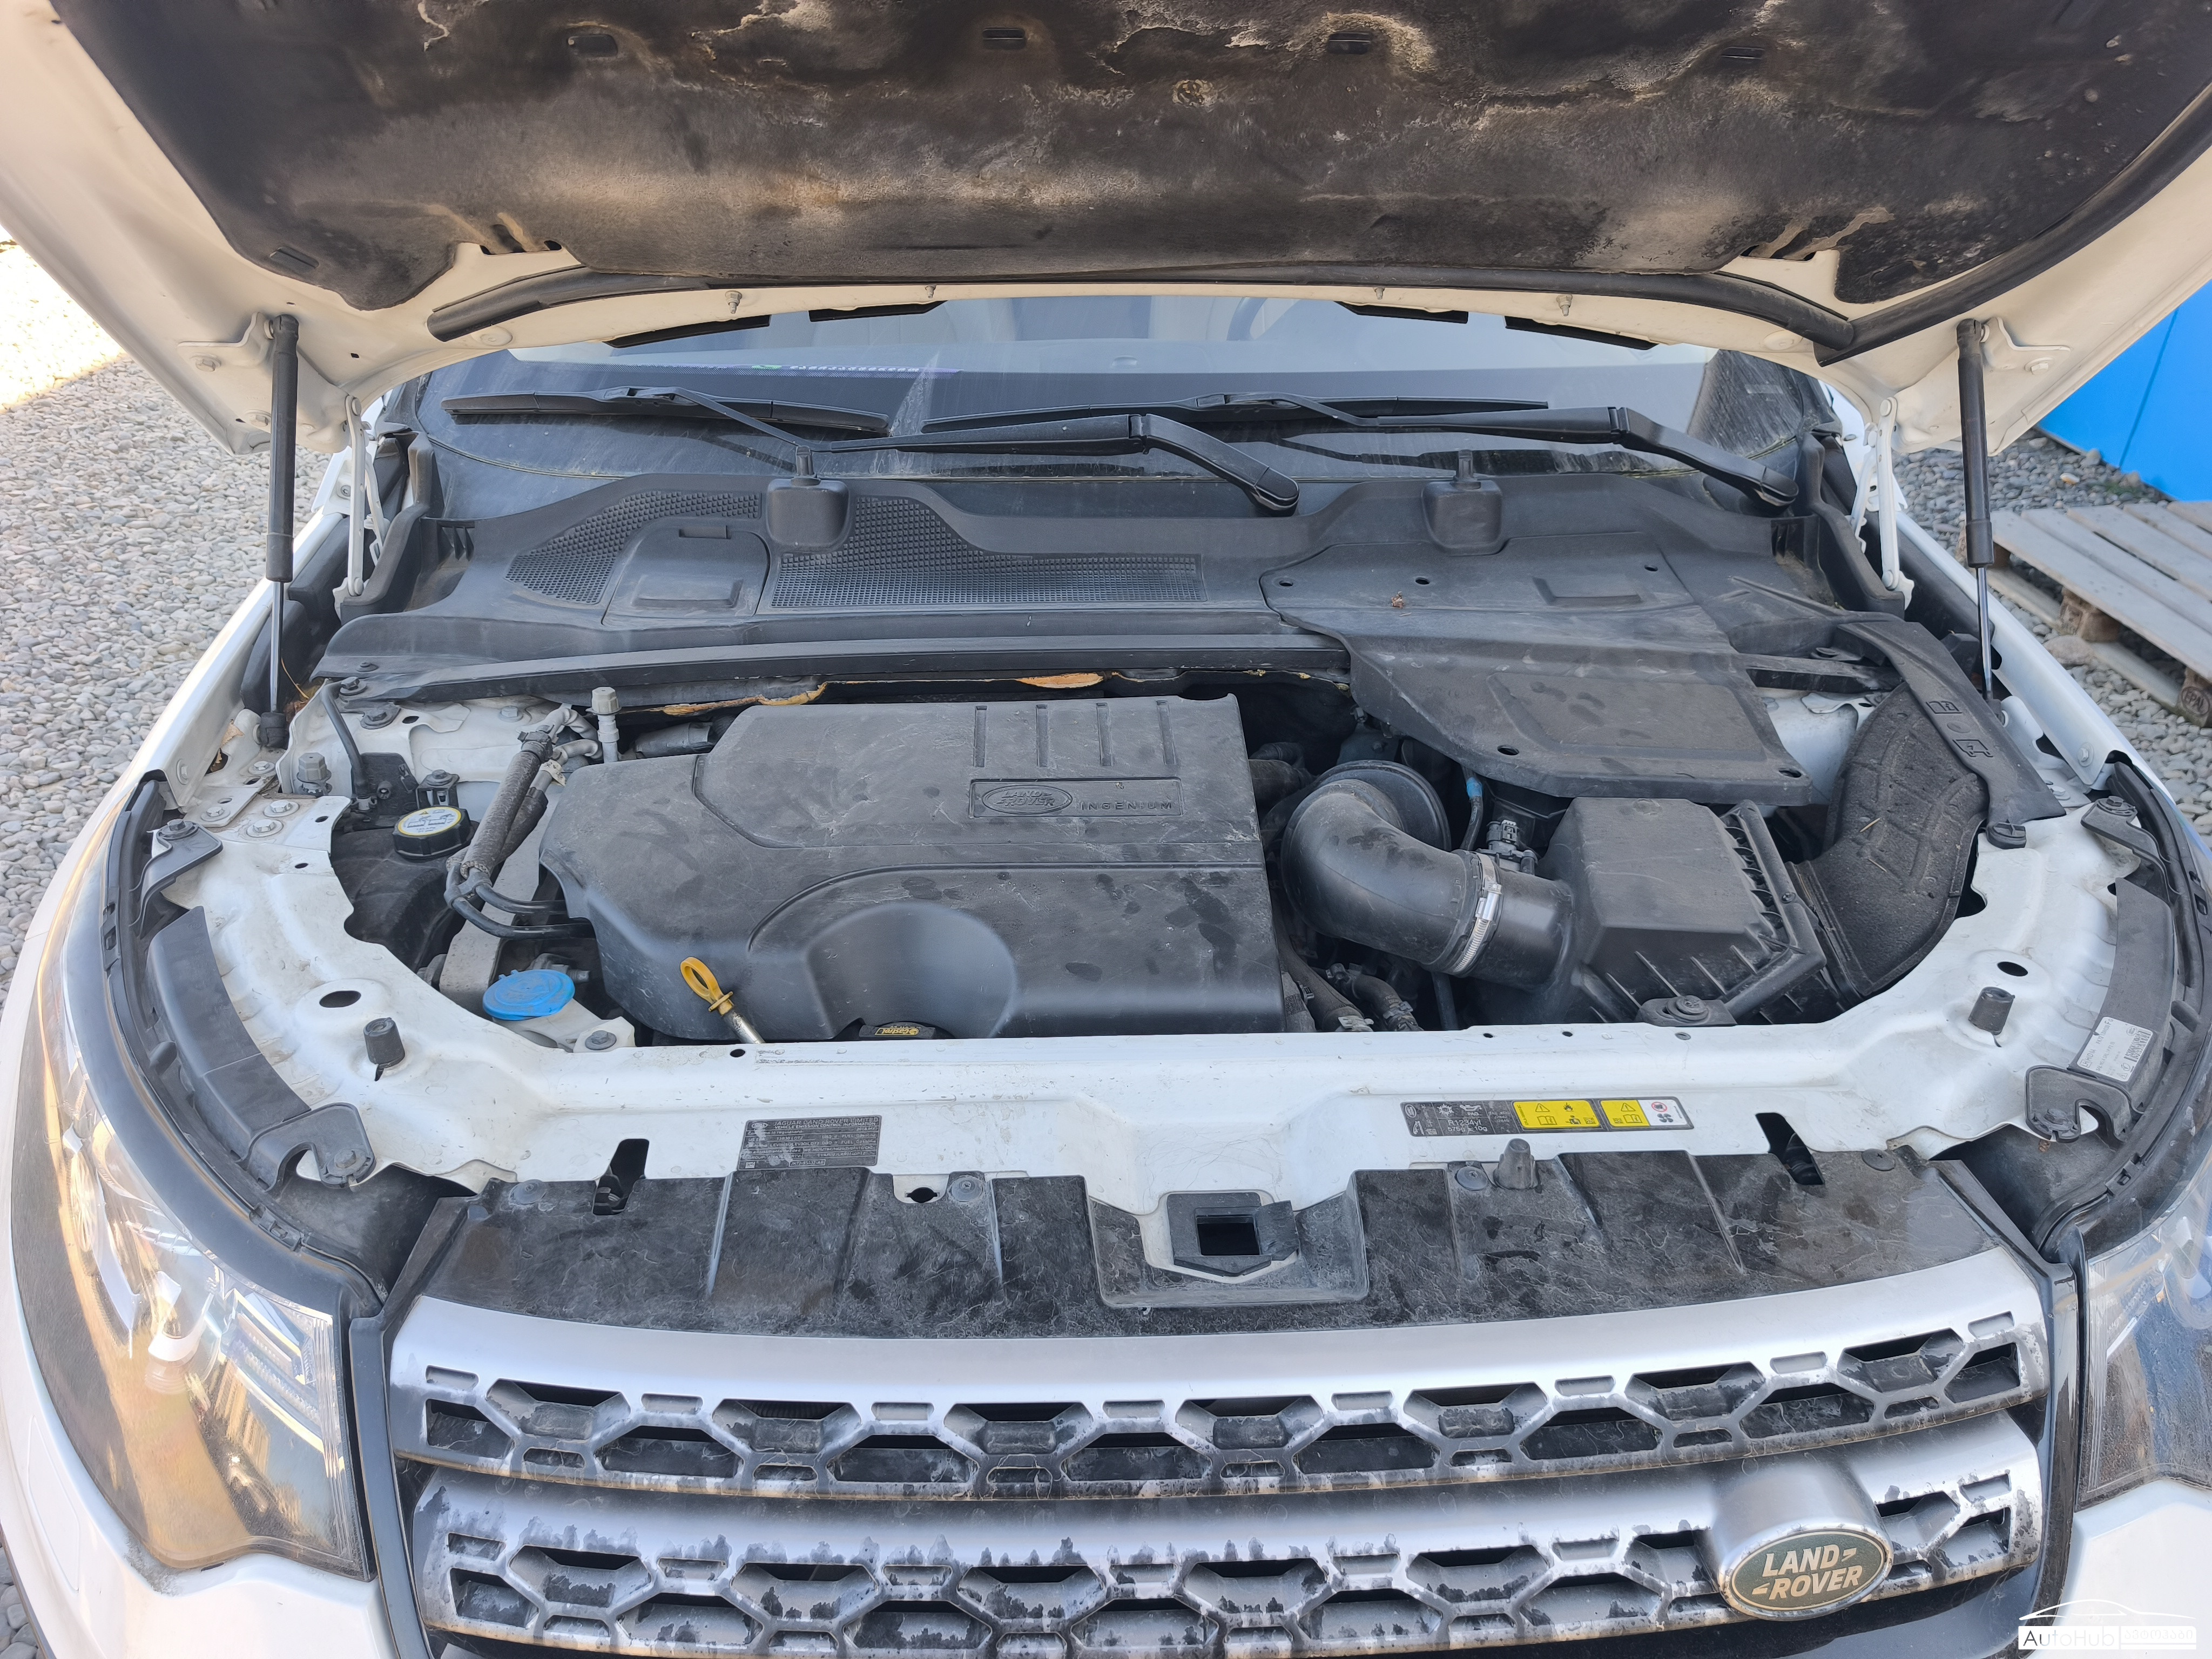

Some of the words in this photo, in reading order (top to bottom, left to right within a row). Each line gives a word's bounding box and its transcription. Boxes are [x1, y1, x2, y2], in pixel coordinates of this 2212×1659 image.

[1080, 801, 1173, 811] INGENIUM
[1448, 1118, 1482, 1127] R1234yf
[1761, 1543, 1840, 1578] LAND
[1768, 1564, 1863, 1601] ROVER
